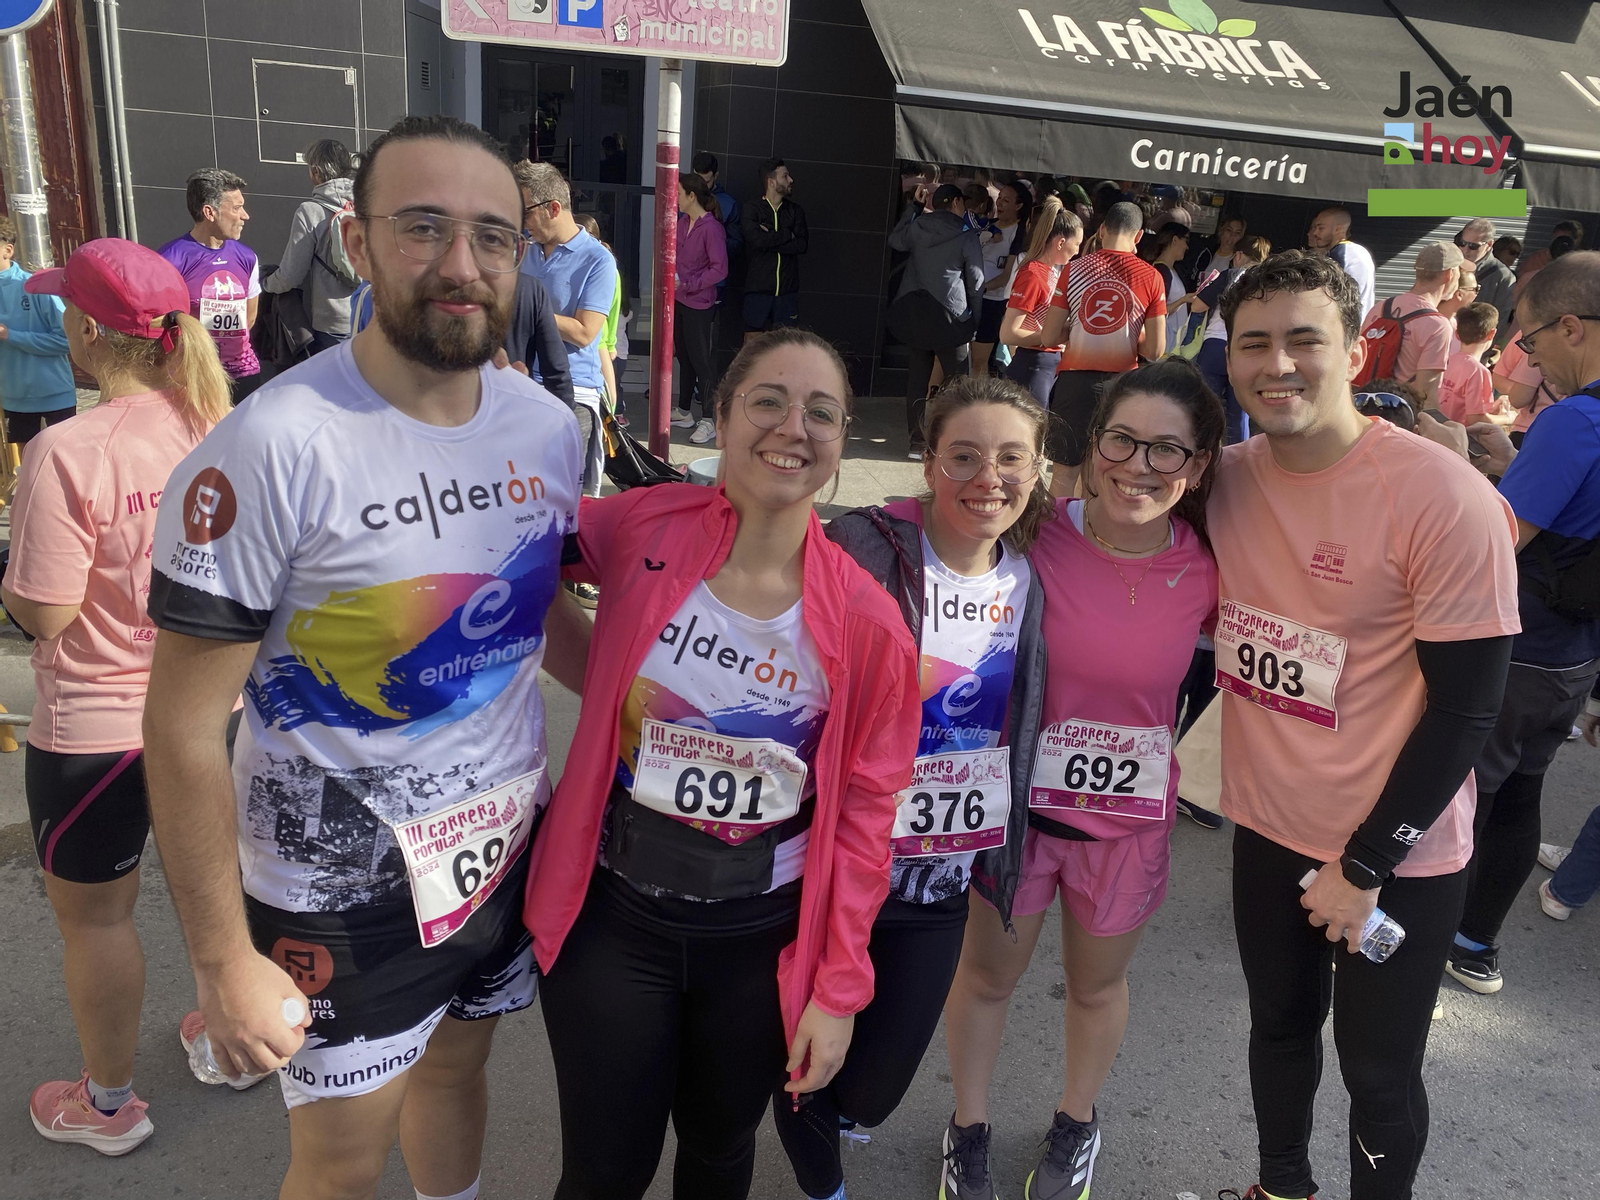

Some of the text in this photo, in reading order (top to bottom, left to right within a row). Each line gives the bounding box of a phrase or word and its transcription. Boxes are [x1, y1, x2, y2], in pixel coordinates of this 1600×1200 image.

[640, 19, 775, 52] municipal
[1018, 8, 1321, 80] LA FÁBRICA
[1131, 138, 1308, 184] Carnicería
[1100, 282, 1128, 295] ZANCADA
[213, 314, 239, 330] 904
[126, 490, 145, 515] III
[360, 460, 545, 539] calderón
[1311, 571, 1321, 579] San
[1322, 574, 1335, 582] Juan
[1335, 577, 1354, 585] Bosco
[418, 635, 537, 687] entrénate
[658, 615, 798, 692] alderón
[1237, 642, 1305, 697] 903
[746, 688, 791, 708] desde 1949
[650, 725, 665, 742] III
[920, 721, 989, 741] ntrénate
[645, 761, 670, 770] 2024
[1064, 753, 1140, 794] 692
[675, 767, 763, 820] 691
[910, 789, 985, 834] 376
[405, 824, 423, 847] III
[416, 862, 440, 878] 2024
[281, 1045, 418, 1088] lub running
